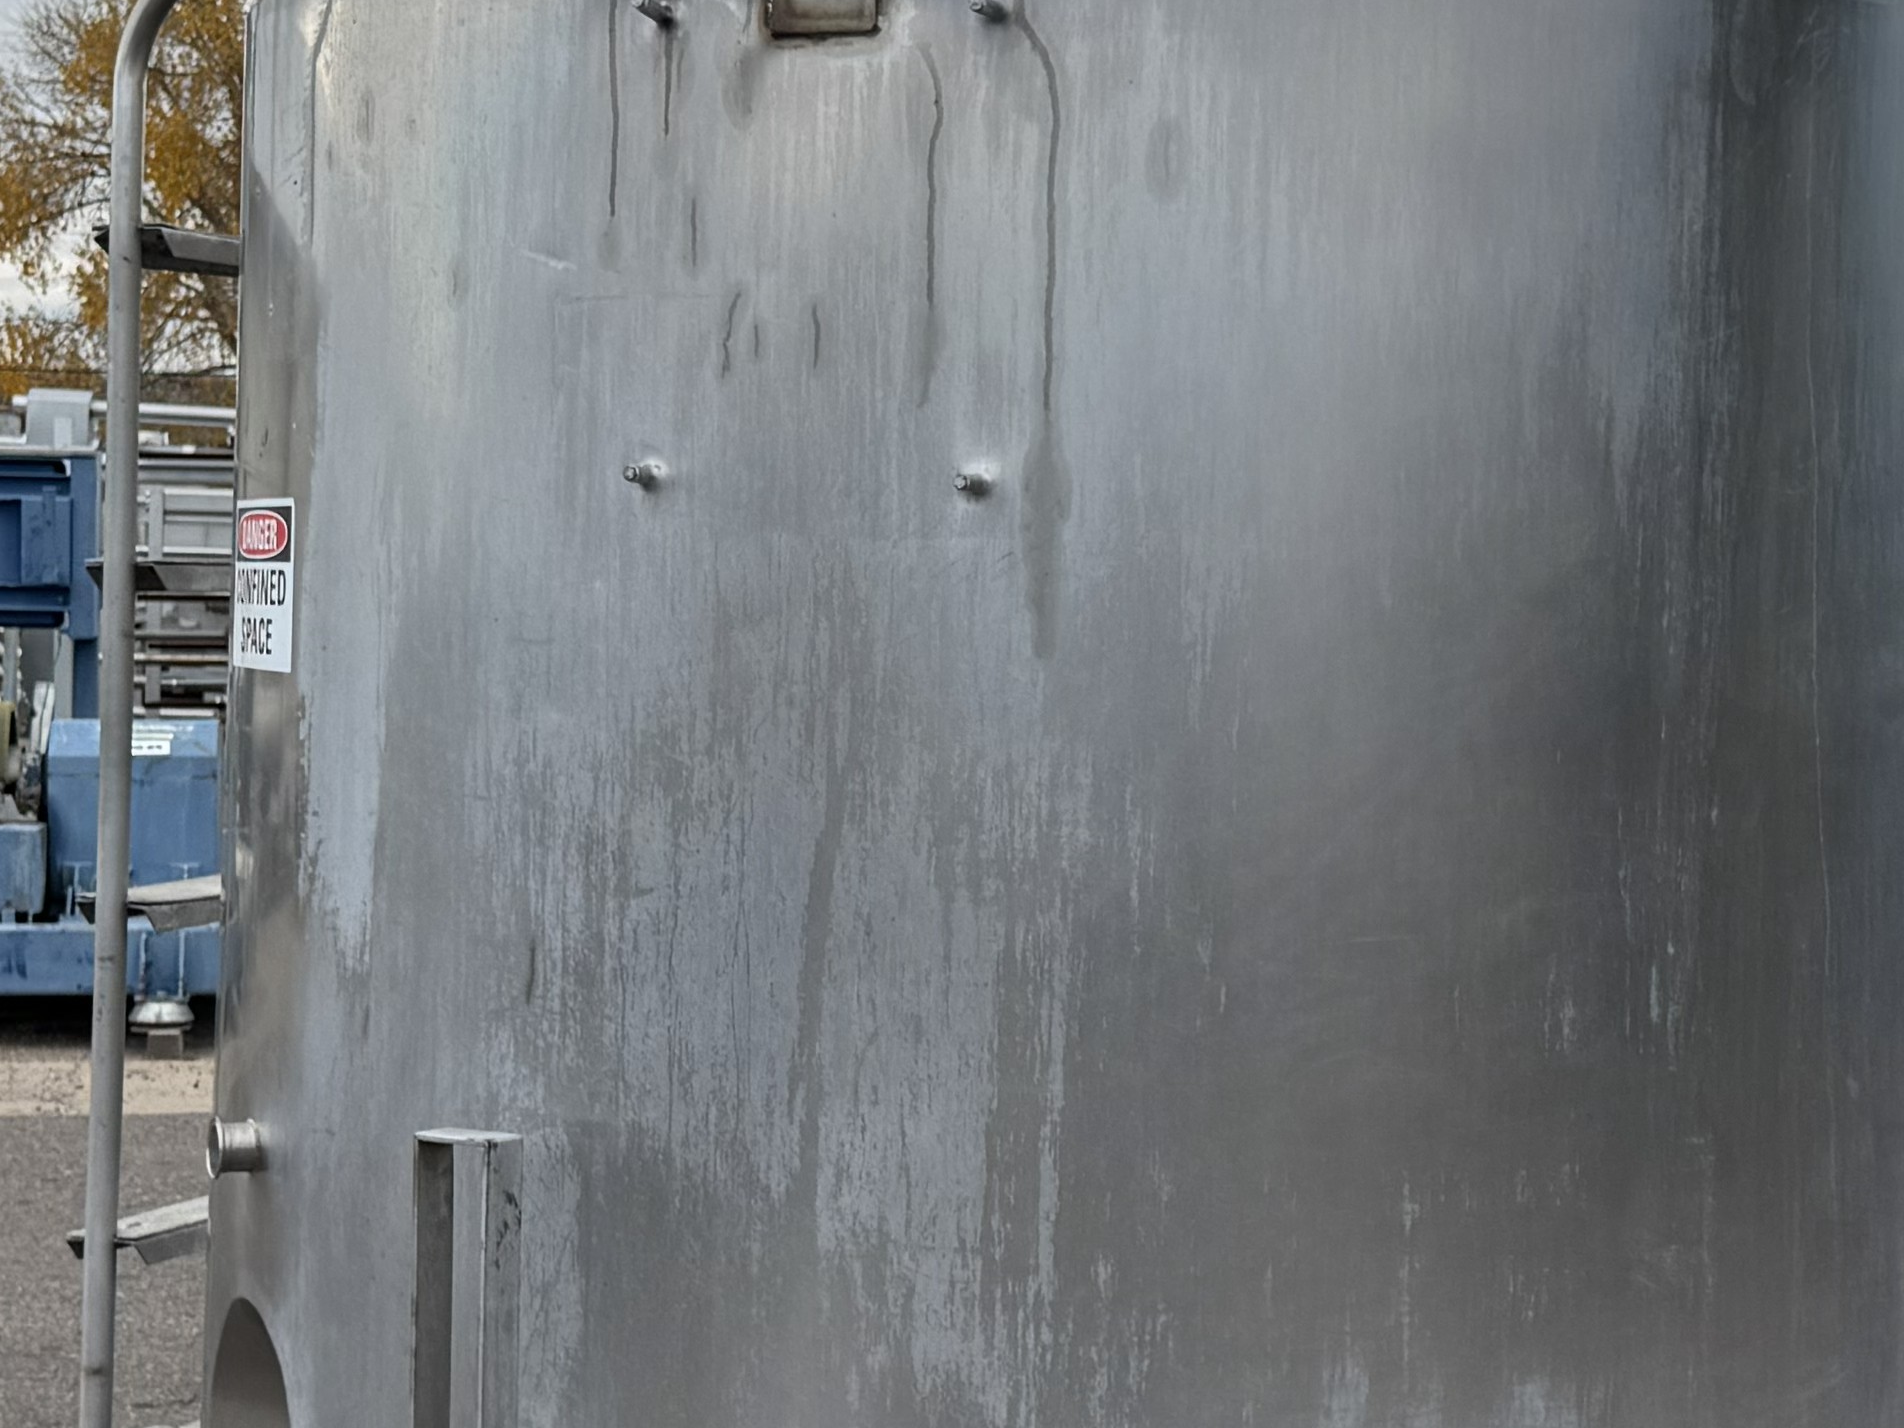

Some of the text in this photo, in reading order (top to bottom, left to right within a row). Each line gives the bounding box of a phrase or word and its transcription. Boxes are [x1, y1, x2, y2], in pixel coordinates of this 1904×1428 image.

[242, 519, 278, 551] DANGER
[237, 569, 287, 606] CONFINED
[241, 616, 273, 655] SPACE
